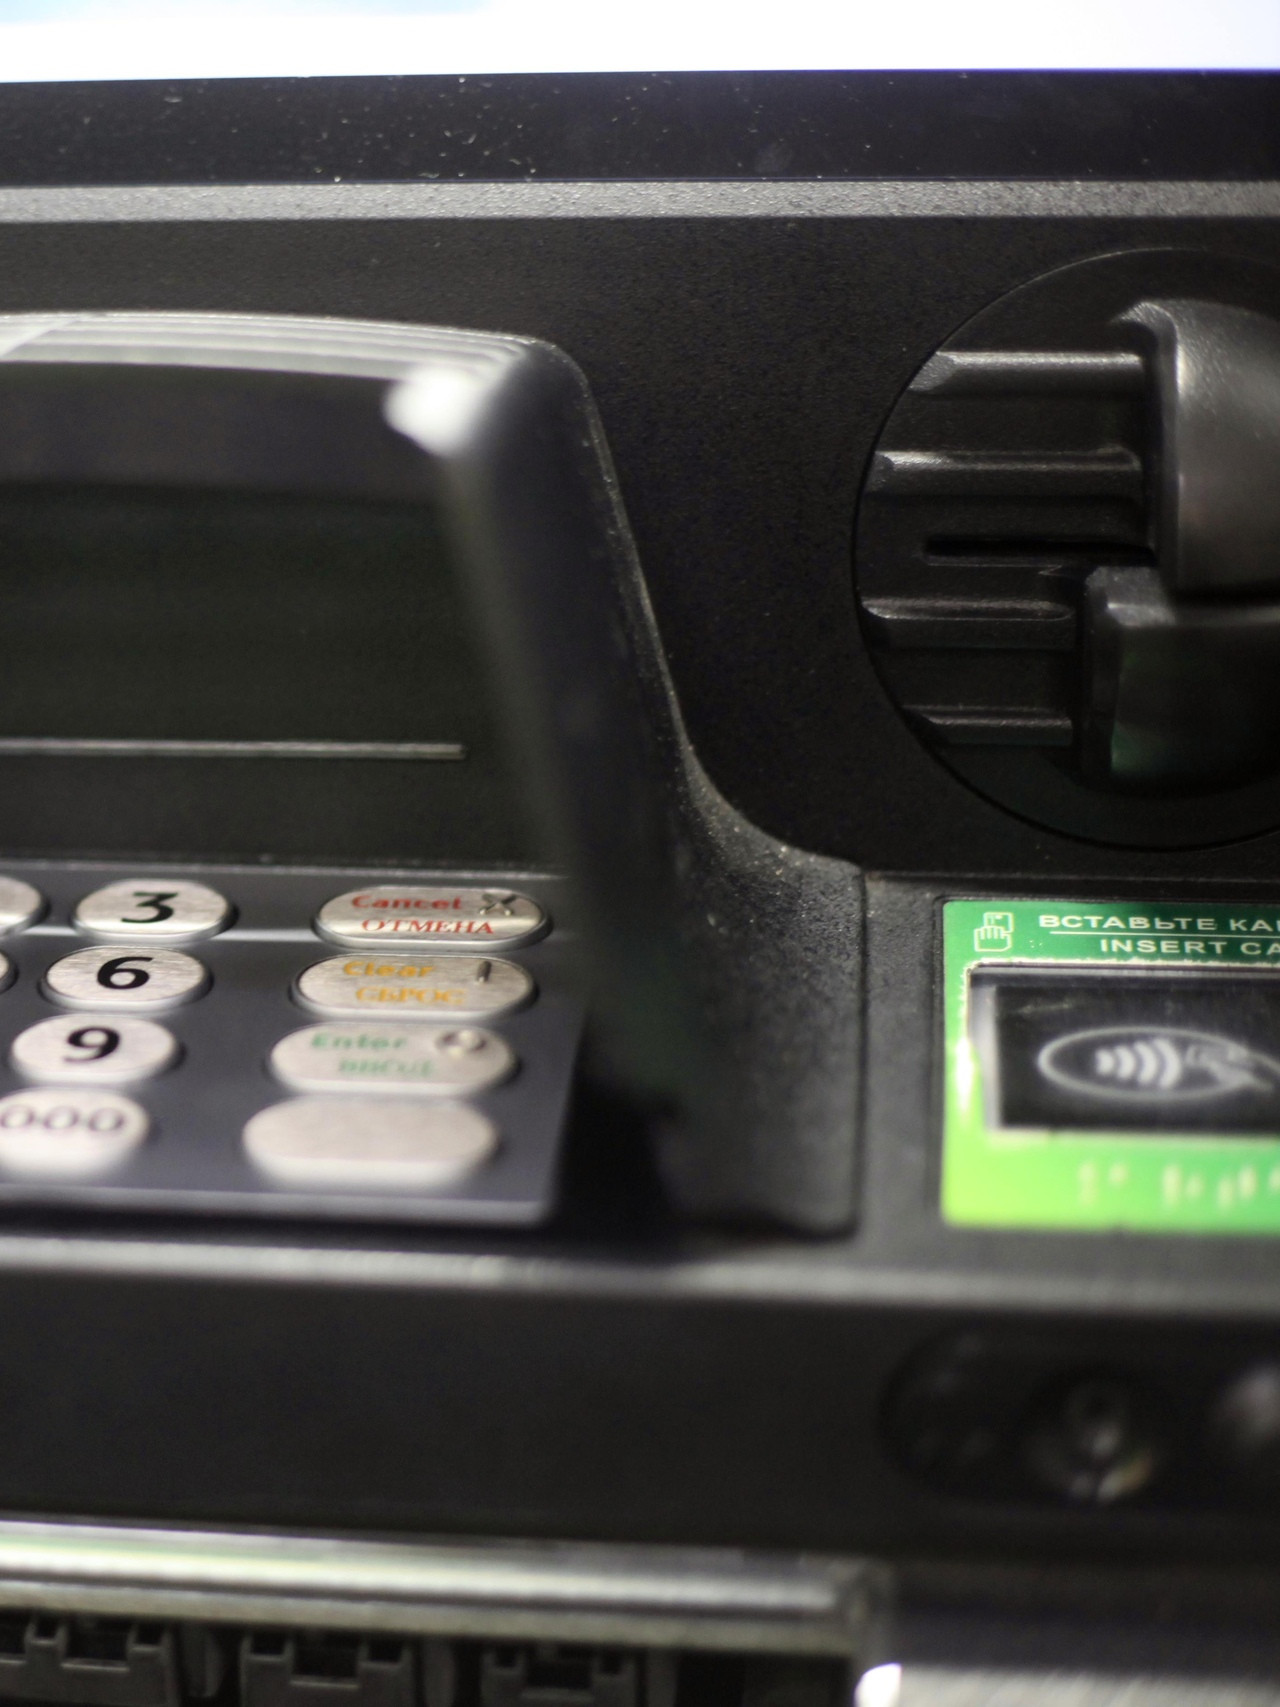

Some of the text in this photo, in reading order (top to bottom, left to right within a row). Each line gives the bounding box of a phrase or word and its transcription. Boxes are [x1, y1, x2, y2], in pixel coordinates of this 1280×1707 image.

[120, 891, 179, 924] 3
[350, 894, 463, 911] Cancel
[361, 917, 494, 935] ОТМЕНА
[1038, 914, 1280, 932] ВСТАВЬТЕ КА
[1099, 938, 1228, 955] INSERT
[95, 956, 154, 990] 6
[343, 959, 437, 978] Clear
[64, 1026, 122, 1062] 9
